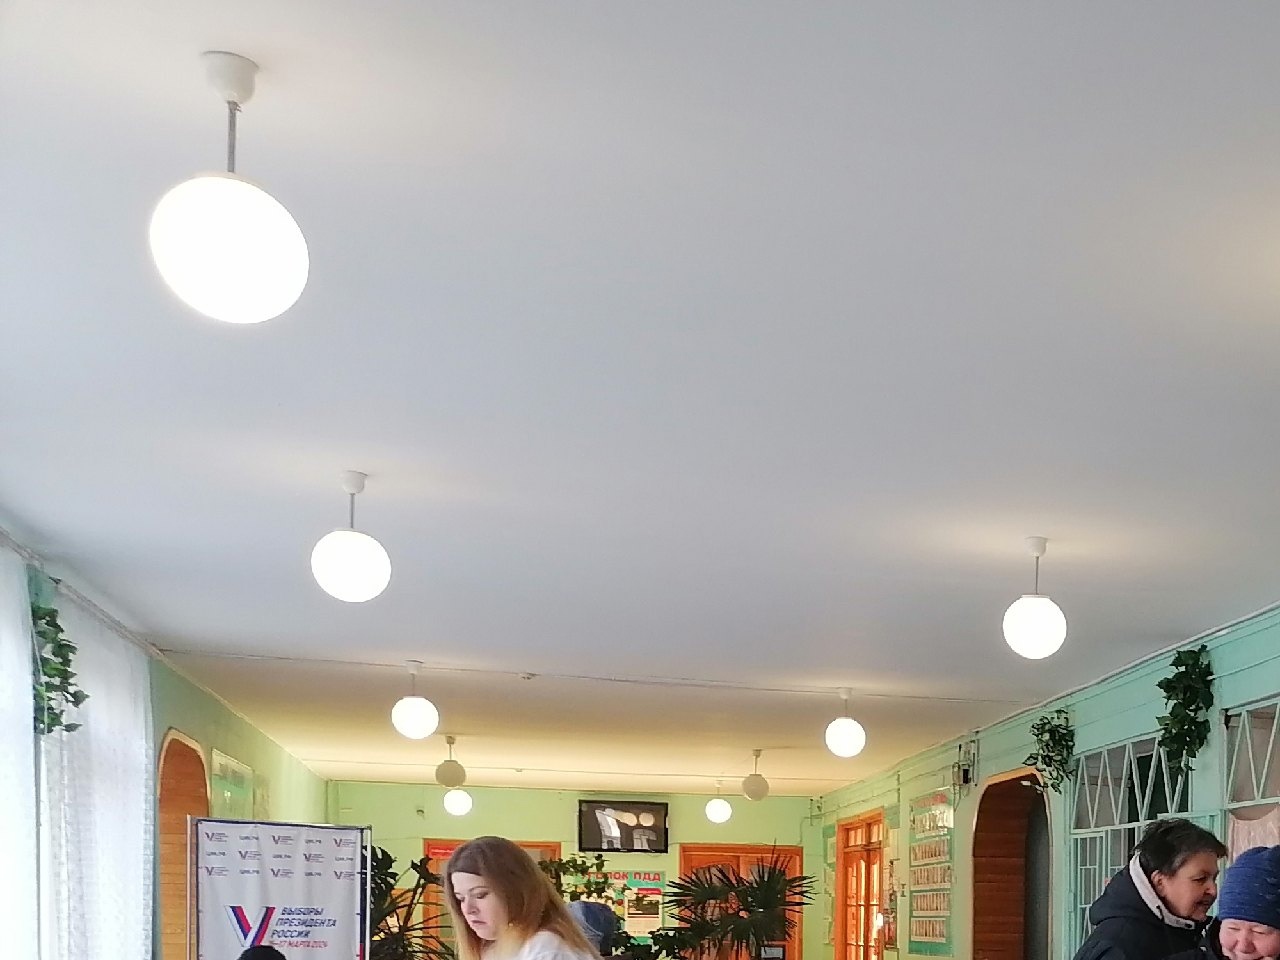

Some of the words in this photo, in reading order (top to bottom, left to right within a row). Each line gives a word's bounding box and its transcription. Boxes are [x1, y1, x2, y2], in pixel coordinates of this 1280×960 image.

[583, 871, 629, 880] ГОЛОК
[633, 871, 661, 882] ПДД
[281, 906, 324, 916] ВЫБОРЫ
[275, 917, 337, 928] ПРЕЗИДЕНТА
[271, 929, 311, 939] РОССИИ
